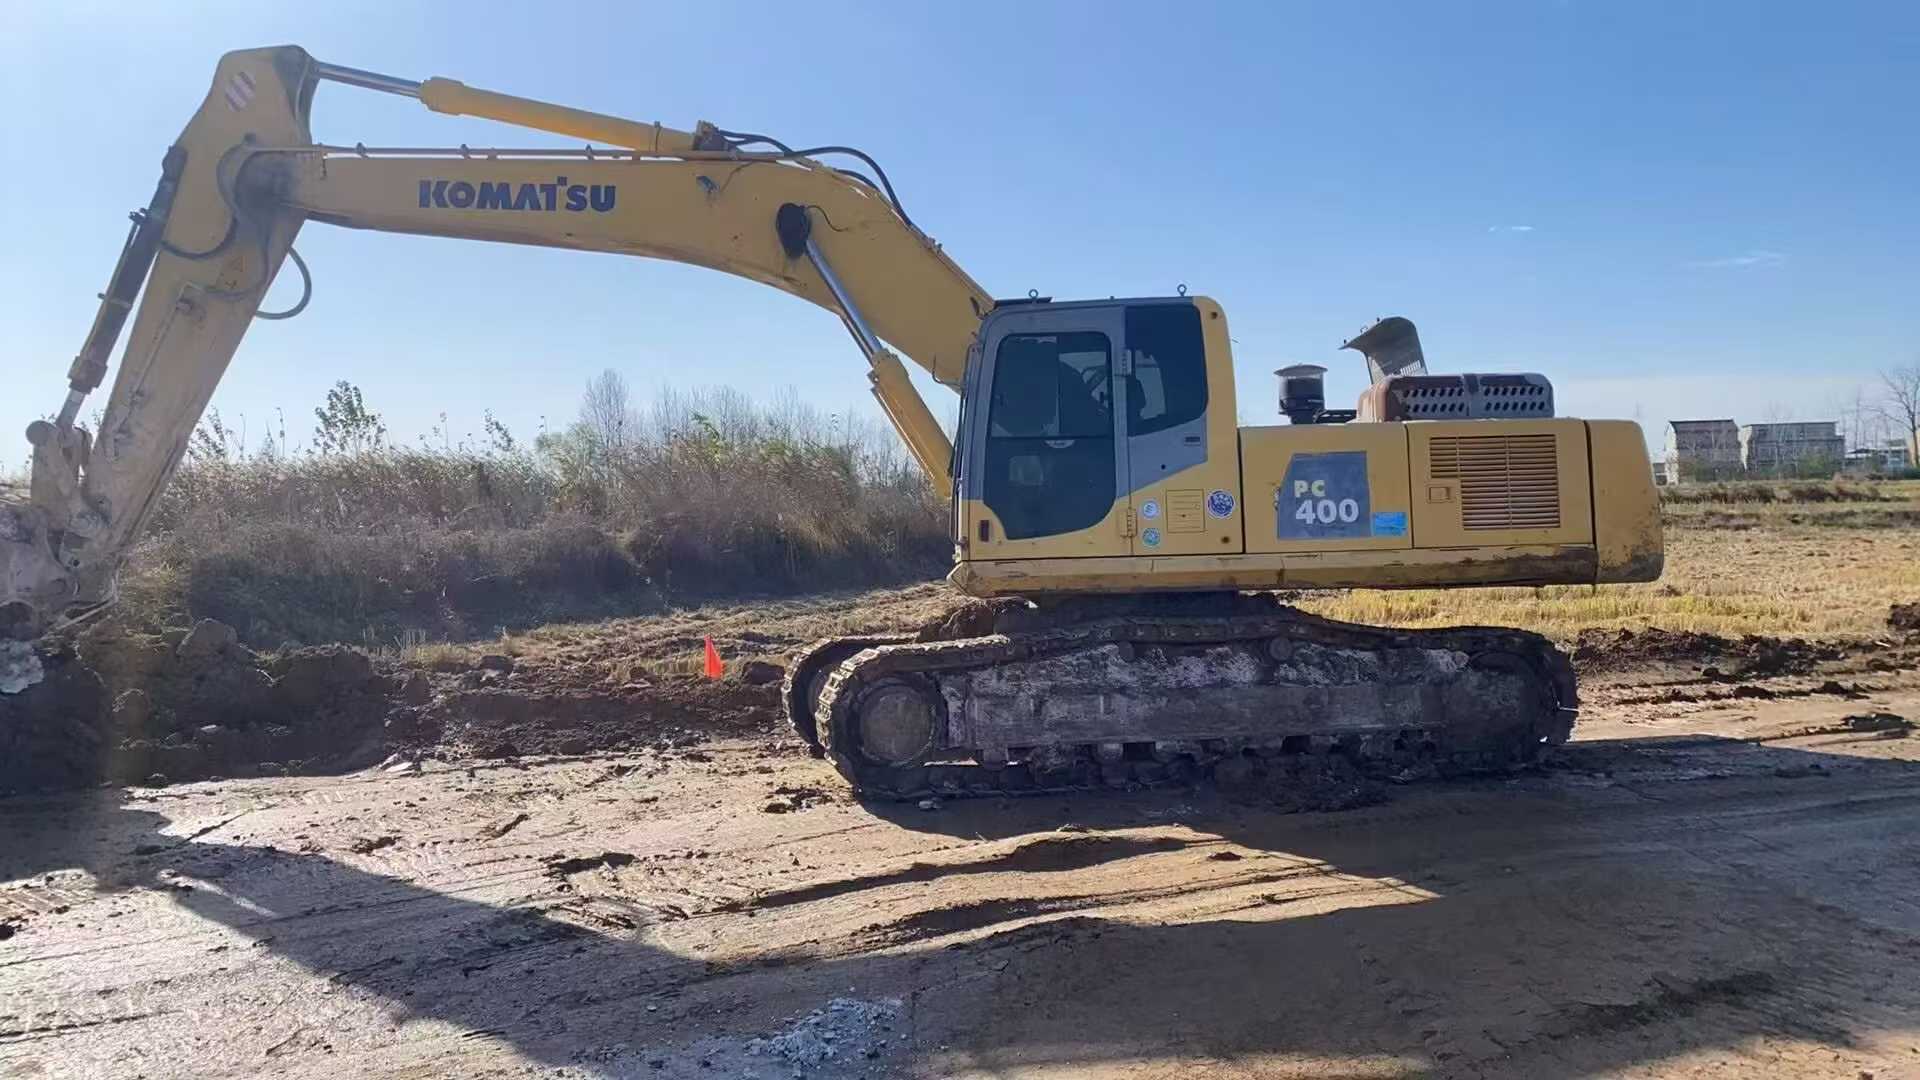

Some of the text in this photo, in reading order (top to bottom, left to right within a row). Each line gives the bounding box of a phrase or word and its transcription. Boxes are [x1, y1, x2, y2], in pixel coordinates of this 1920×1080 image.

[418, 176, 616, 212] KOMATSU
[1294, 479, 1326, 498] PC
[1295, 498, 1359, 525] 400
